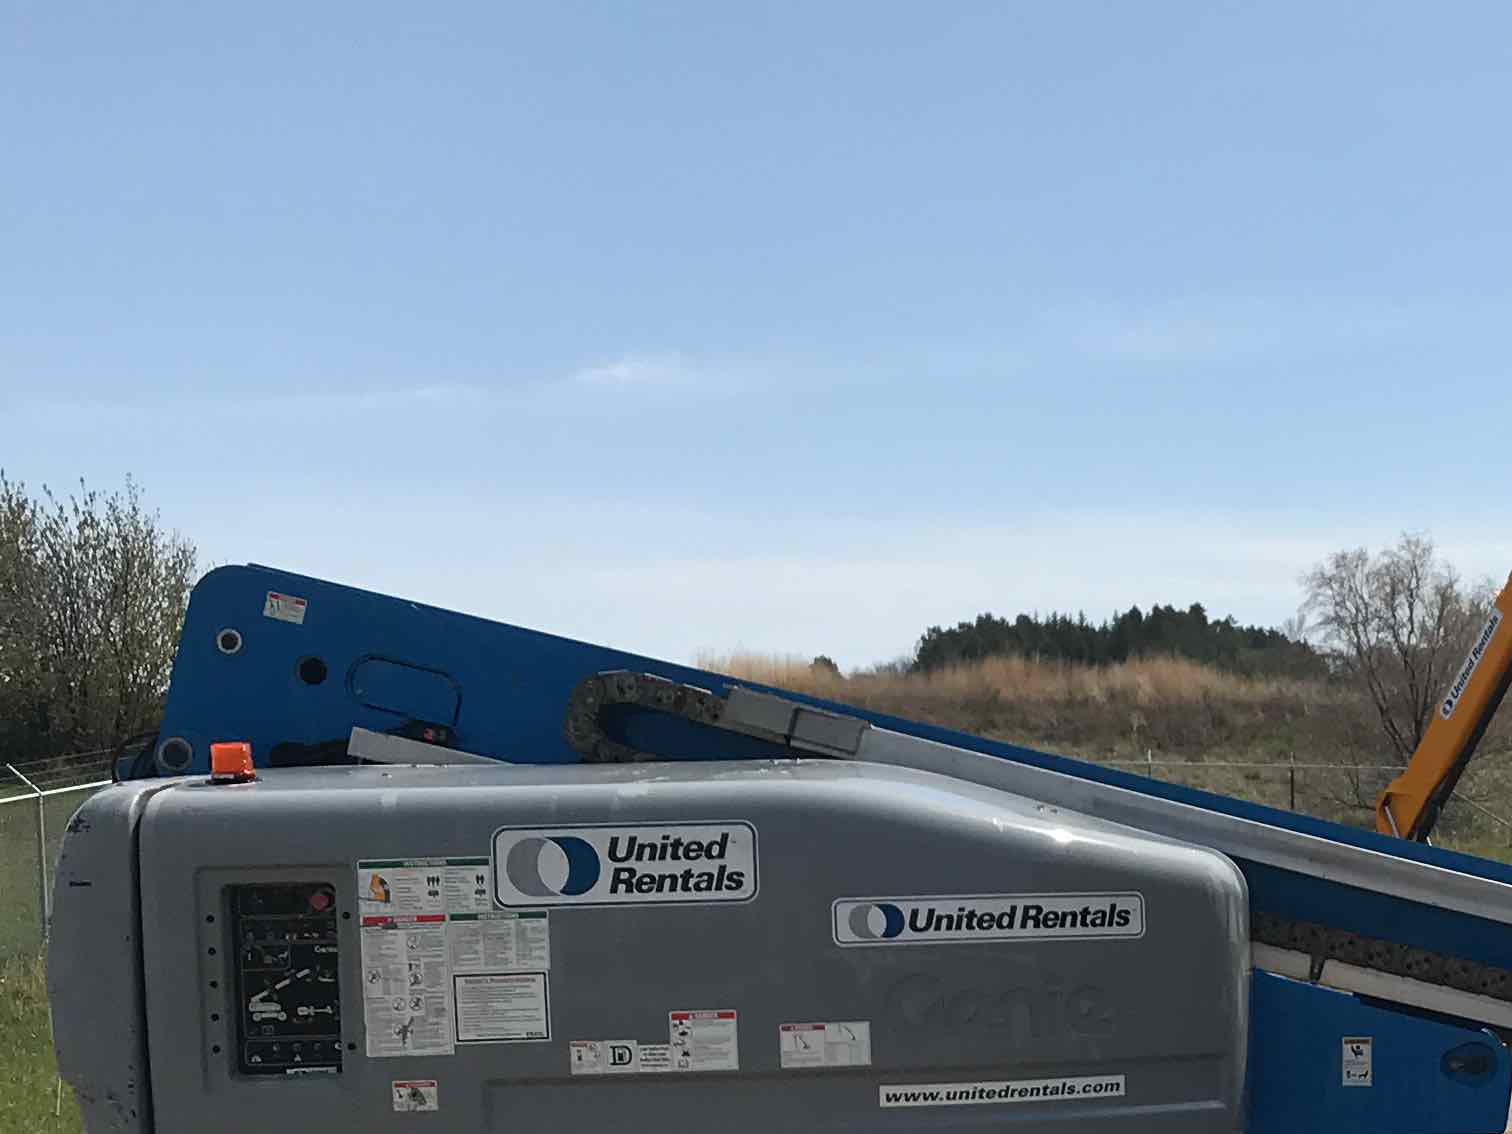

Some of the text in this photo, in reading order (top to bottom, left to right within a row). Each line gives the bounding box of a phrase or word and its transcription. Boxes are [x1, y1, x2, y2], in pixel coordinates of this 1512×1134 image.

[1451, 616, 1499, 698] United Rentals
[608, 833, 729, 862] United
[609, 864, 745, 894] Rentals
[908, 903, 1132, 932] United Rentals
[885, 1081, 1121, 1103] www.unitedrentals.com
